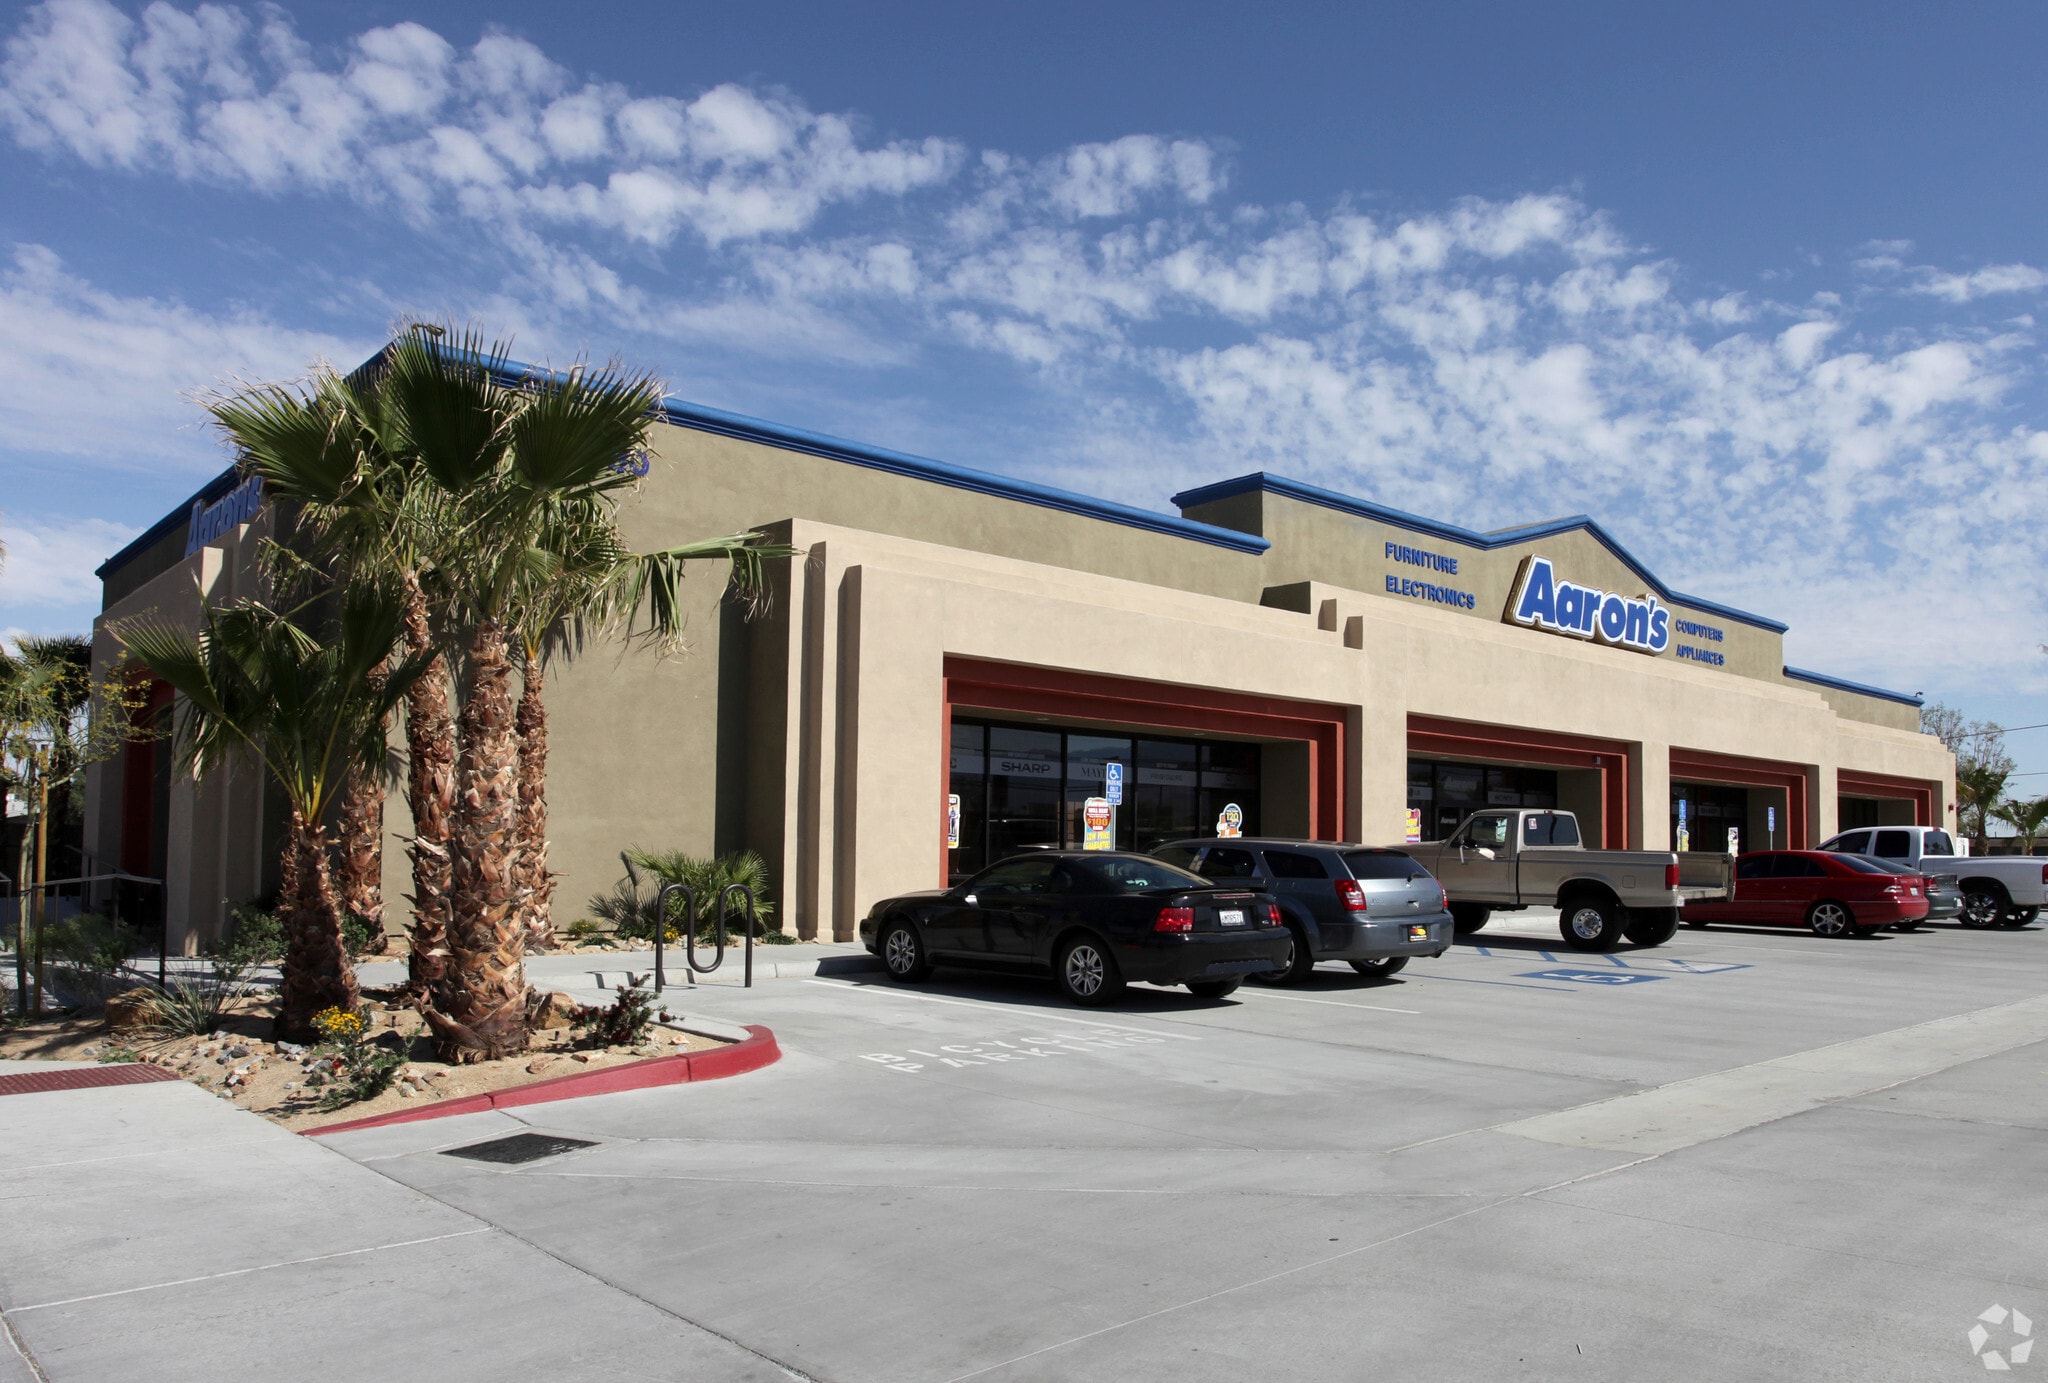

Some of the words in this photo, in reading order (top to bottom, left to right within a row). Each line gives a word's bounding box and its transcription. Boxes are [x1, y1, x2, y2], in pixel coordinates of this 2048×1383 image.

[1385, 542, 1458, 575] FURNITURE
[1386, 575, 1476, 609] ELECTRONICS
[1514, 558, 1669, 652] Aaron's
[1675, 618, 1724, 643] COMPUTERS
[1676, 643, 1725, 667] APPLIANCES
[1001, 761, 1051, 773] SHARP
[1087, 818, 1108, 826] $100
[1226, 812, 1239, 821] 120
[859, 1029, 1132, 1063] BICYCLE
[884, 1036, 1166, 1074] PARKING
